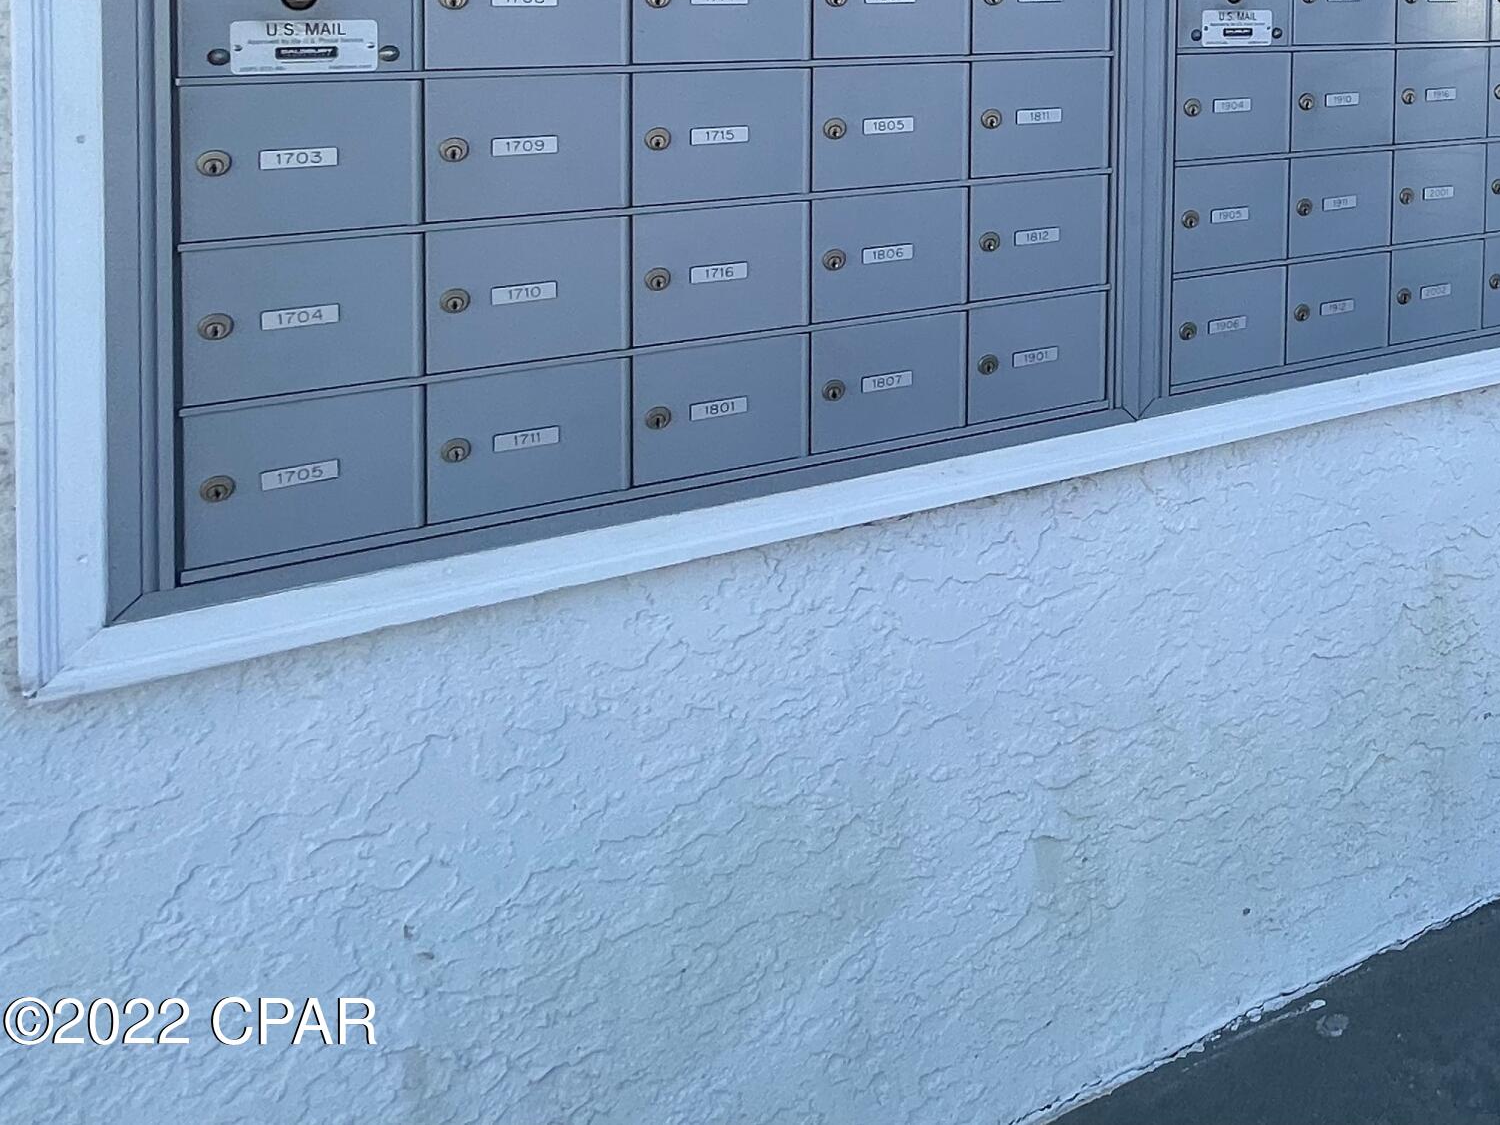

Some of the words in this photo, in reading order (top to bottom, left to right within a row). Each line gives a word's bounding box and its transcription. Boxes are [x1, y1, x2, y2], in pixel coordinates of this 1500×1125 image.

[1237, 11, 1256, 20] MAIL
[305, 22, 346, 35] MAIL
[1221, 100, 1245, 111] 1904
[1029, 110, 1049, 122] 1811
[873, 119, 905, 132] 1805
[704, 129, 735, 142] 1715
[505, 139, 545, 152] 1709
[275, 151, 322, 165] 1703
[1430, 188, 1449, 197] 2001
[1219, 210, 1242, 220] 1905
[1025, 230, 1049, 242] 1812
[872, 248, 904, 260] 1806
[704, 266, 734, 279] 1716
[507, 286, 541, 299] 1710
[276, 309, 323, 324] 1704
[1216, 320, 1240, 330] 1906
[1023, 350, 1049, 363] 1901
[871, 375, 903, 389] 1807
[704, 401, 735, 415] 1801
[513, 432, 541, 445] 1711
[276, 466, 323, 482] 1705
